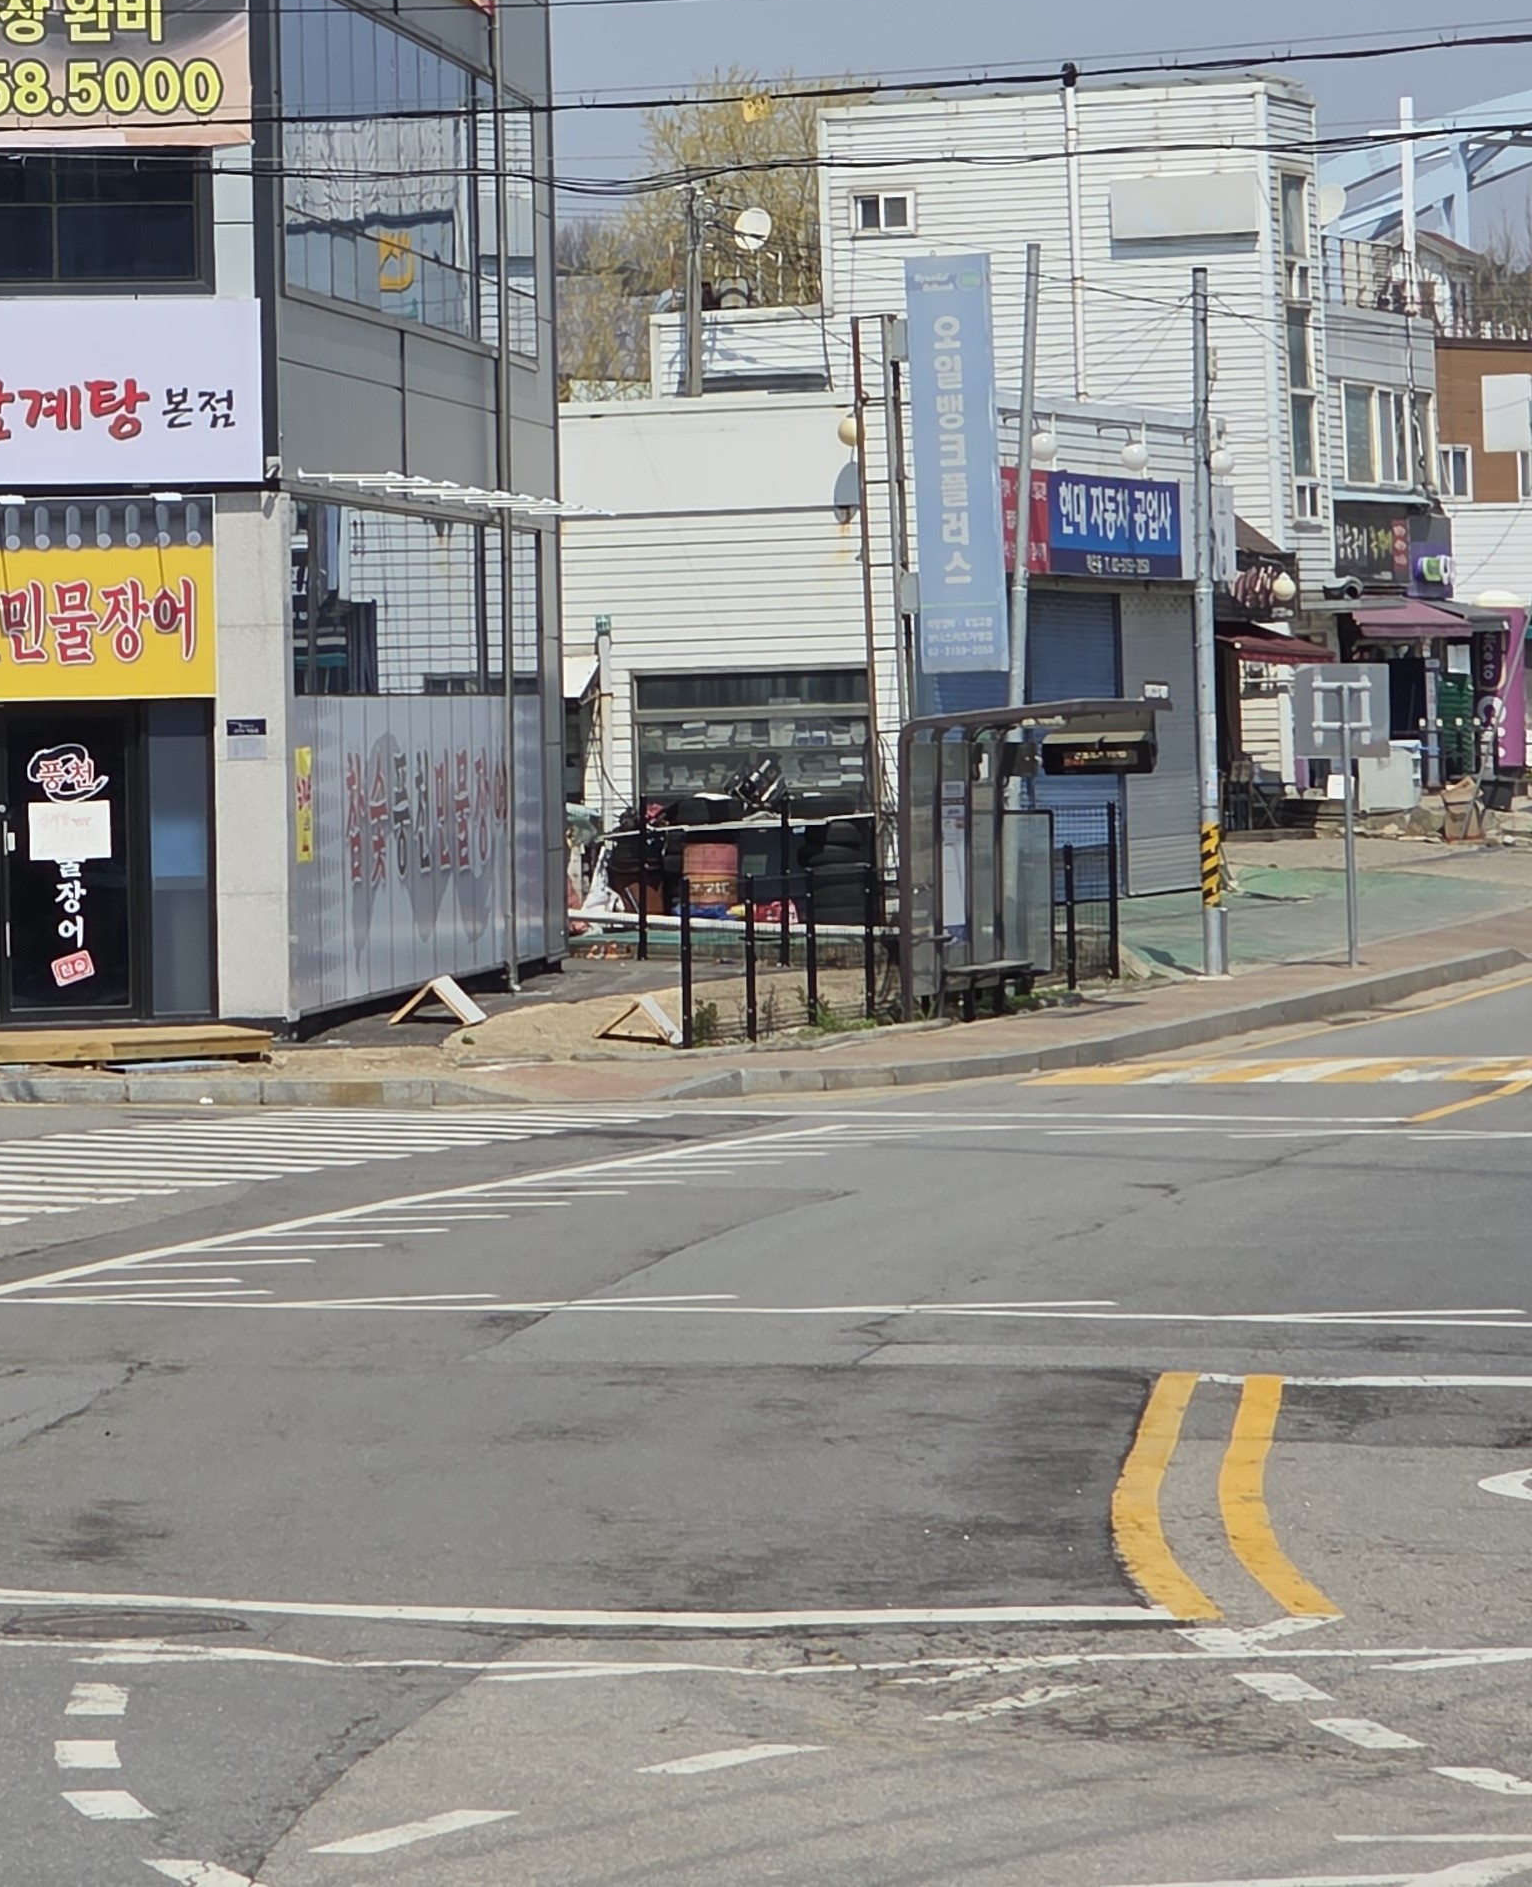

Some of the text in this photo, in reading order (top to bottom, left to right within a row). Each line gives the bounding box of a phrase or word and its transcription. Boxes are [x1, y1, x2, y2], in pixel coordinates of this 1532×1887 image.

[162, 388, 236, 428] 본점
[934, 316, 972, 584] 오일뱅크플러스
[1059, 482, 1087, 535] 현대
[1090, 486, 1130, 540] 자동차
[1134, 491, 1171, 542] 공업사
[36, 759, 94, 791] 풍천
